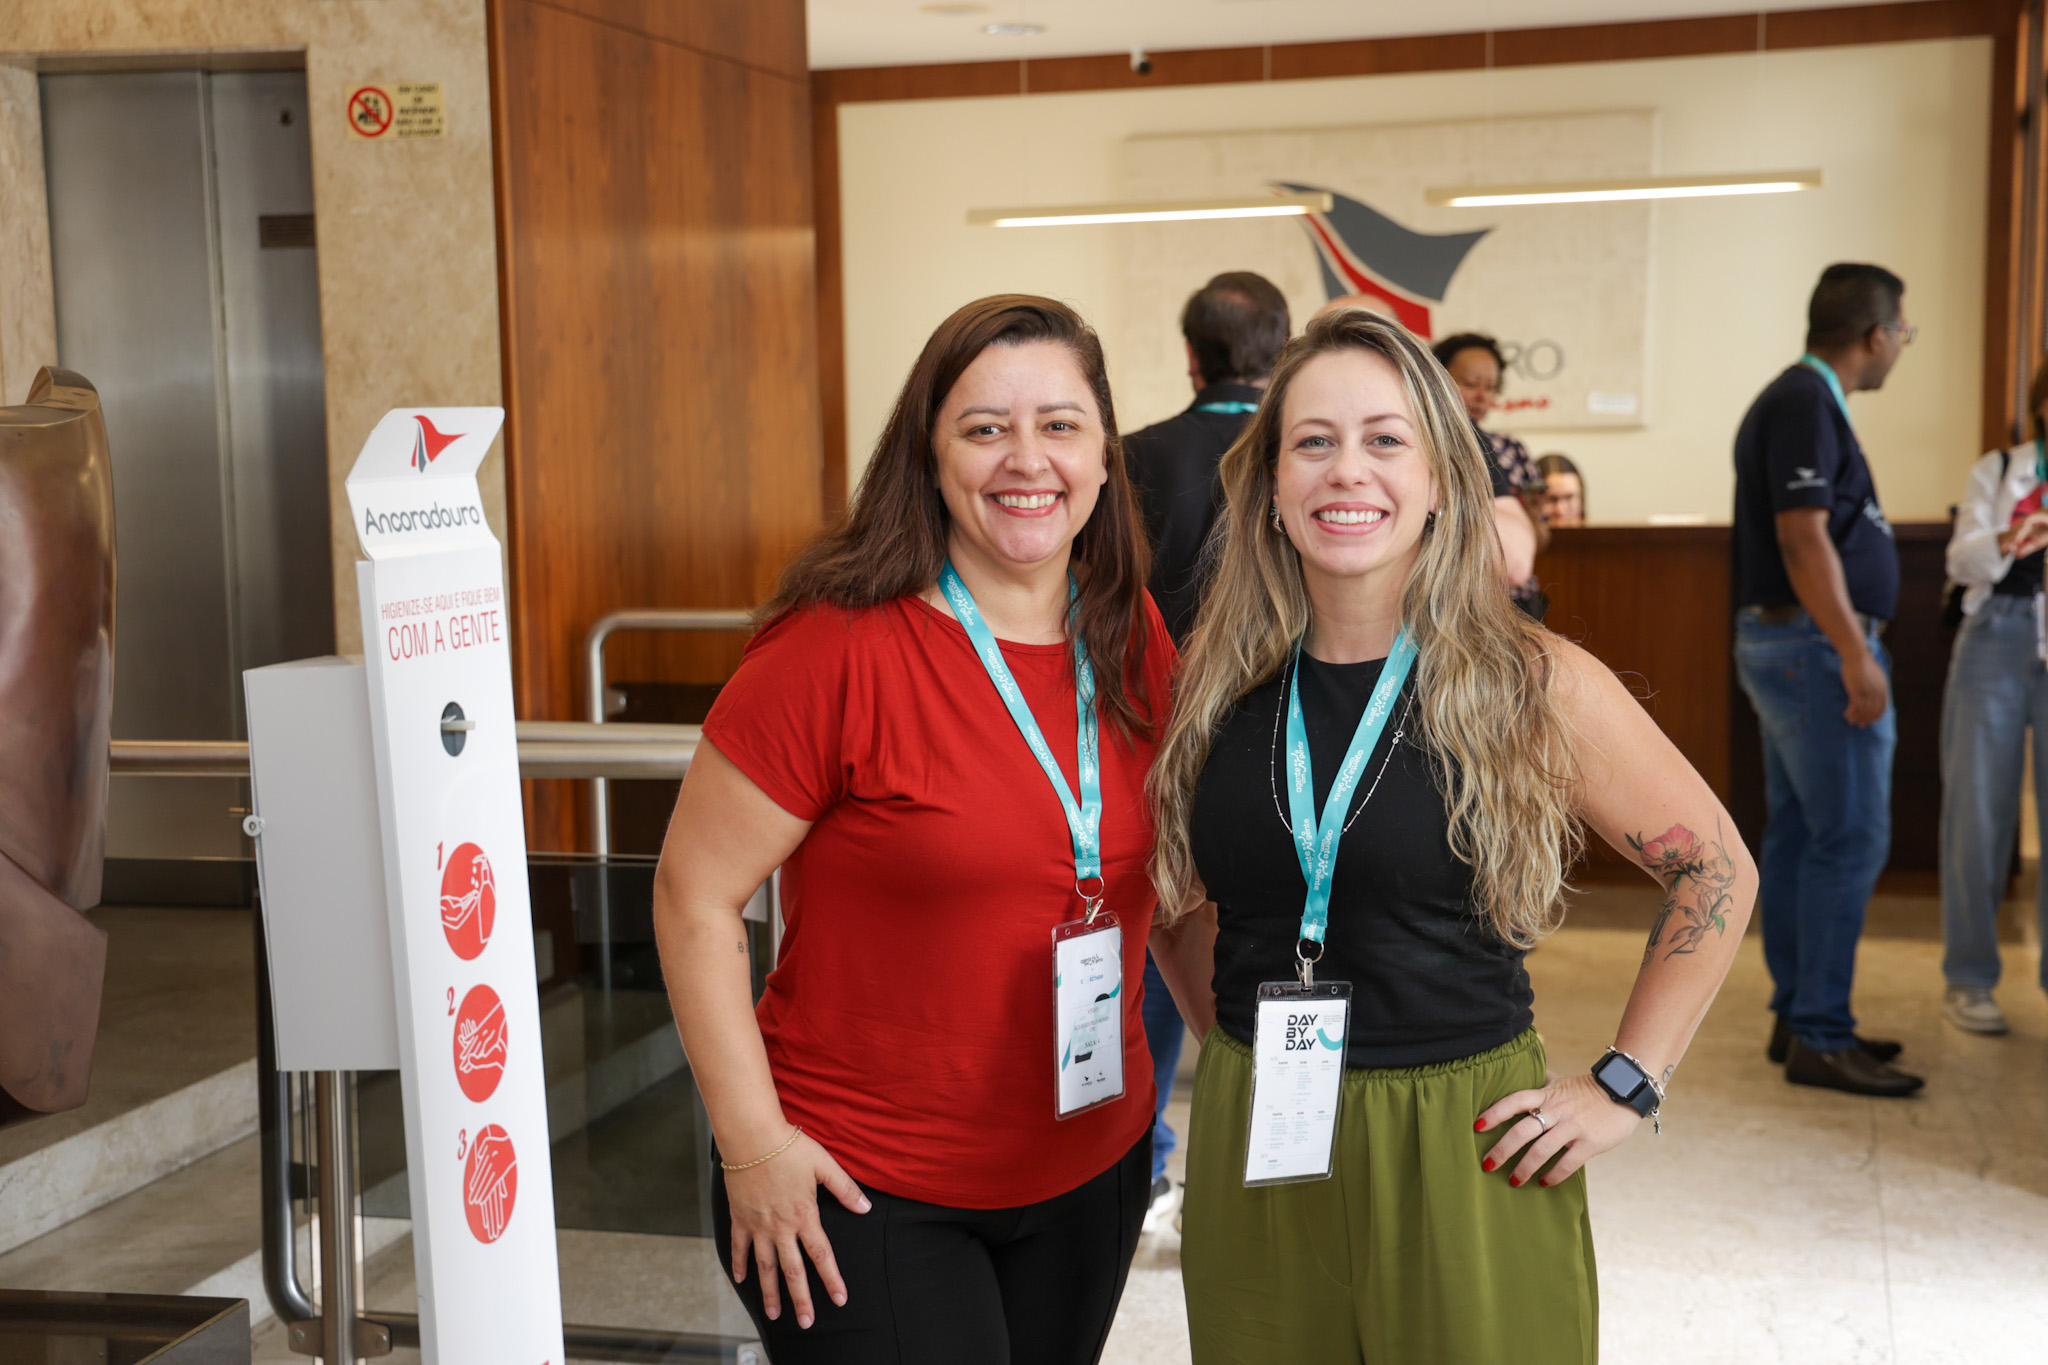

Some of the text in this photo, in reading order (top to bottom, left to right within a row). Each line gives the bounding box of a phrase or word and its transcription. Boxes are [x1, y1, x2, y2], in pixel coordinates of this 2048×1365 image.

[365, 502, 480, 536] Ancoradouro
[381, 586, 500, 620] HIGIENIZE-SE AQUI E FIQUE BEM
[388, 610, 500, 661] COM A GENTE
[437, 840, 443, 871] 1
[447, 986, 455, 1016] 2
[1286, 1027, 1308, 1039] BY
[1287, 1014, 1318, 1026] DAY
[1285, 1038, 1316, 1051] DAY
[457, 1128, 467, 1161] 3
